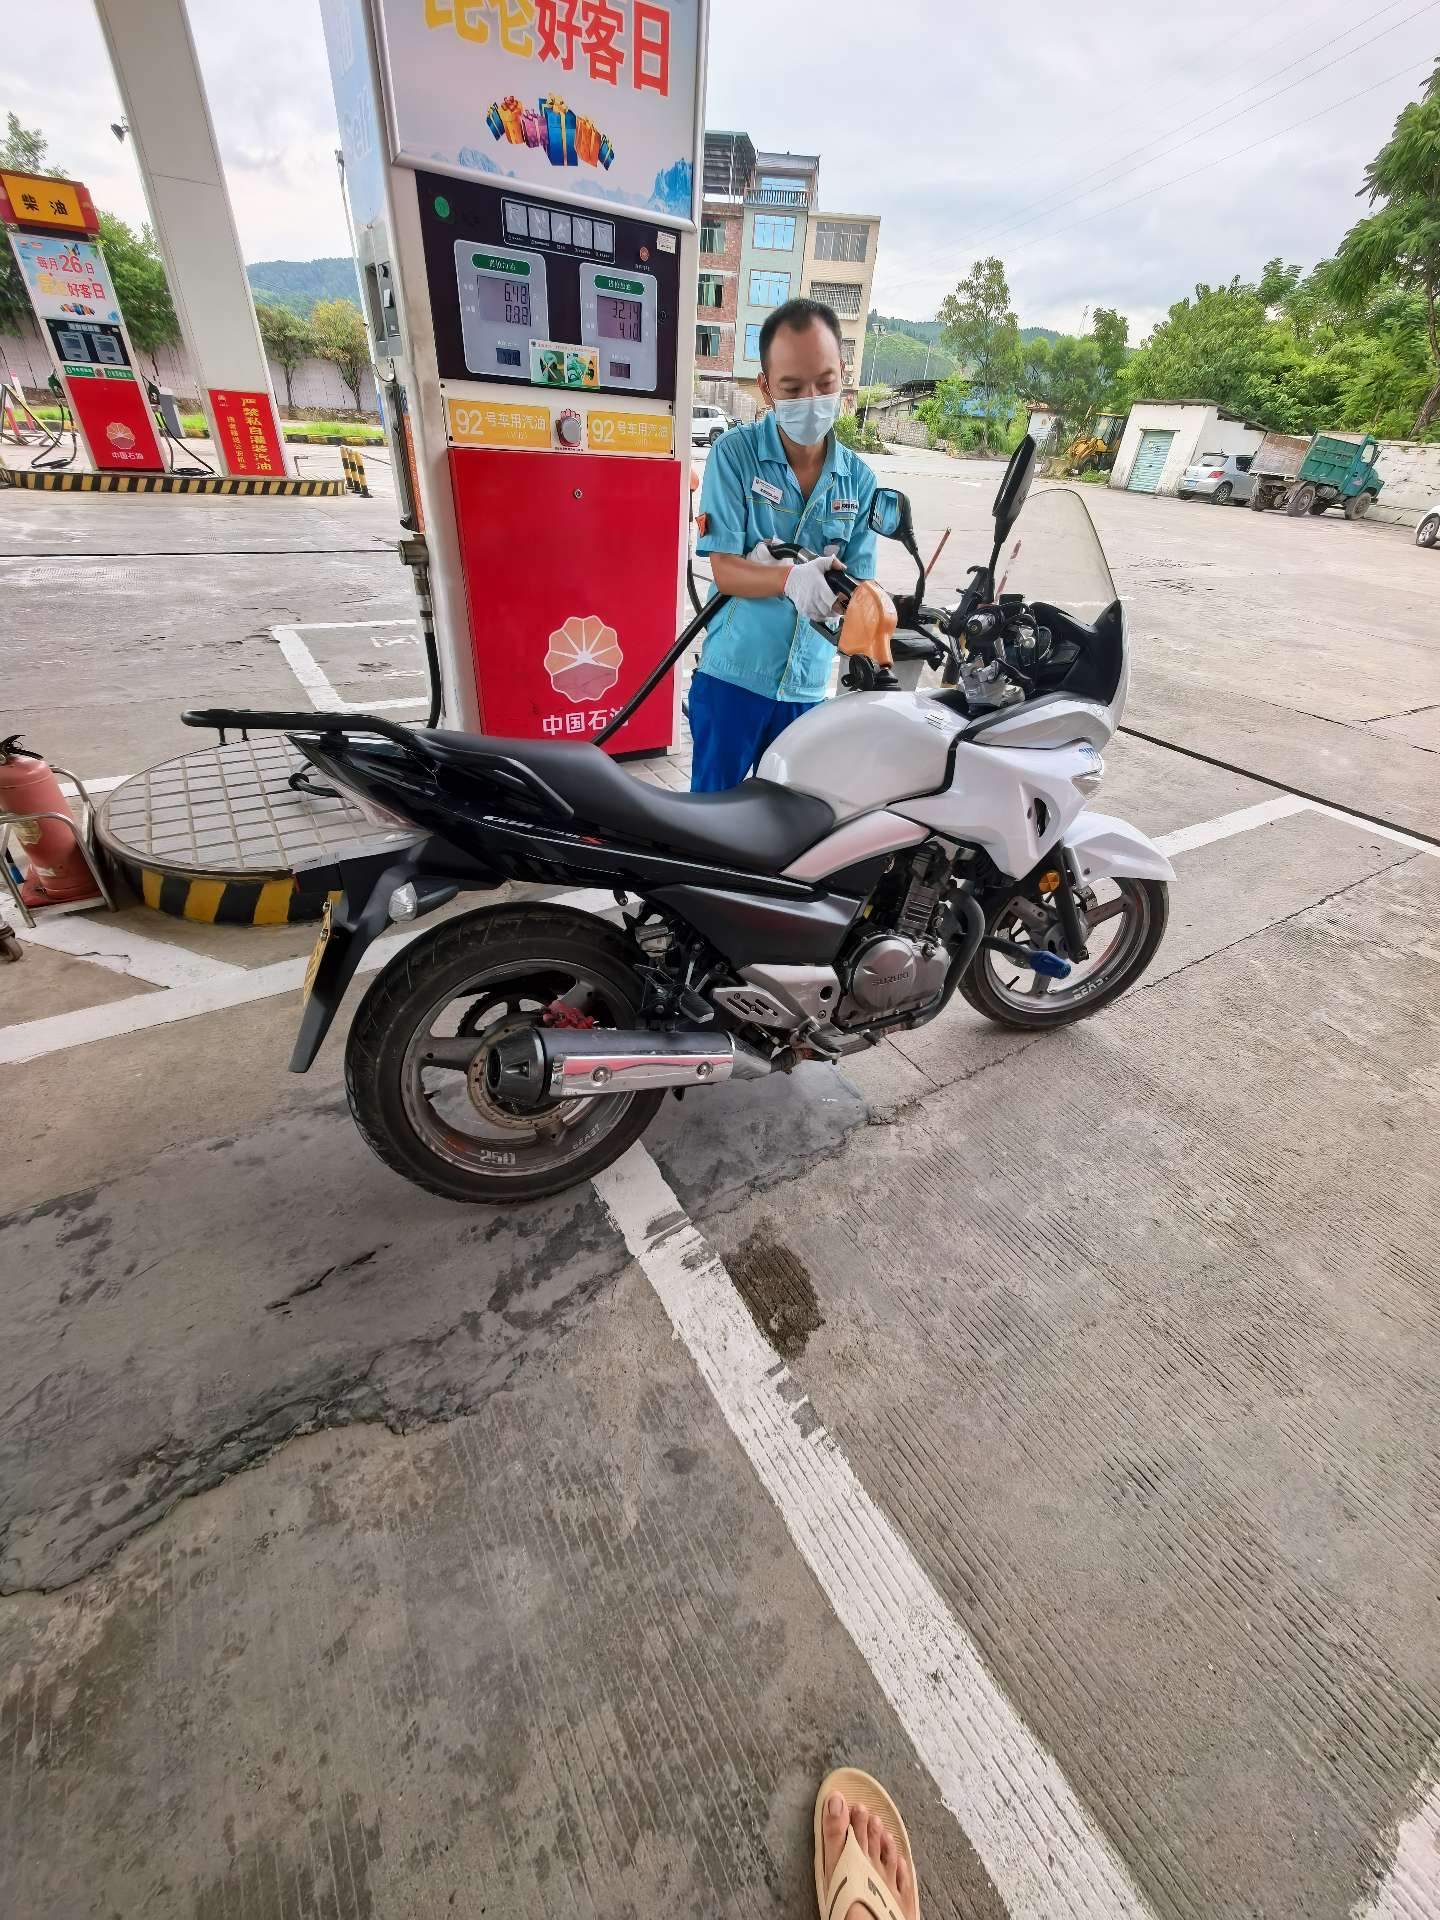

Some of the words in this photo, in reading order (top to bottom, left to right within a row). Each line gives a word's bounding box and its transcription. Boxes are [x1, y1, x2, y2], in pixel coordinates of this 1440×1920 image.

[21, 193, 68, 216] 柴油
[36, 255, 94, 275] 每月26日
[480, 1149, 516, 1165] 250
